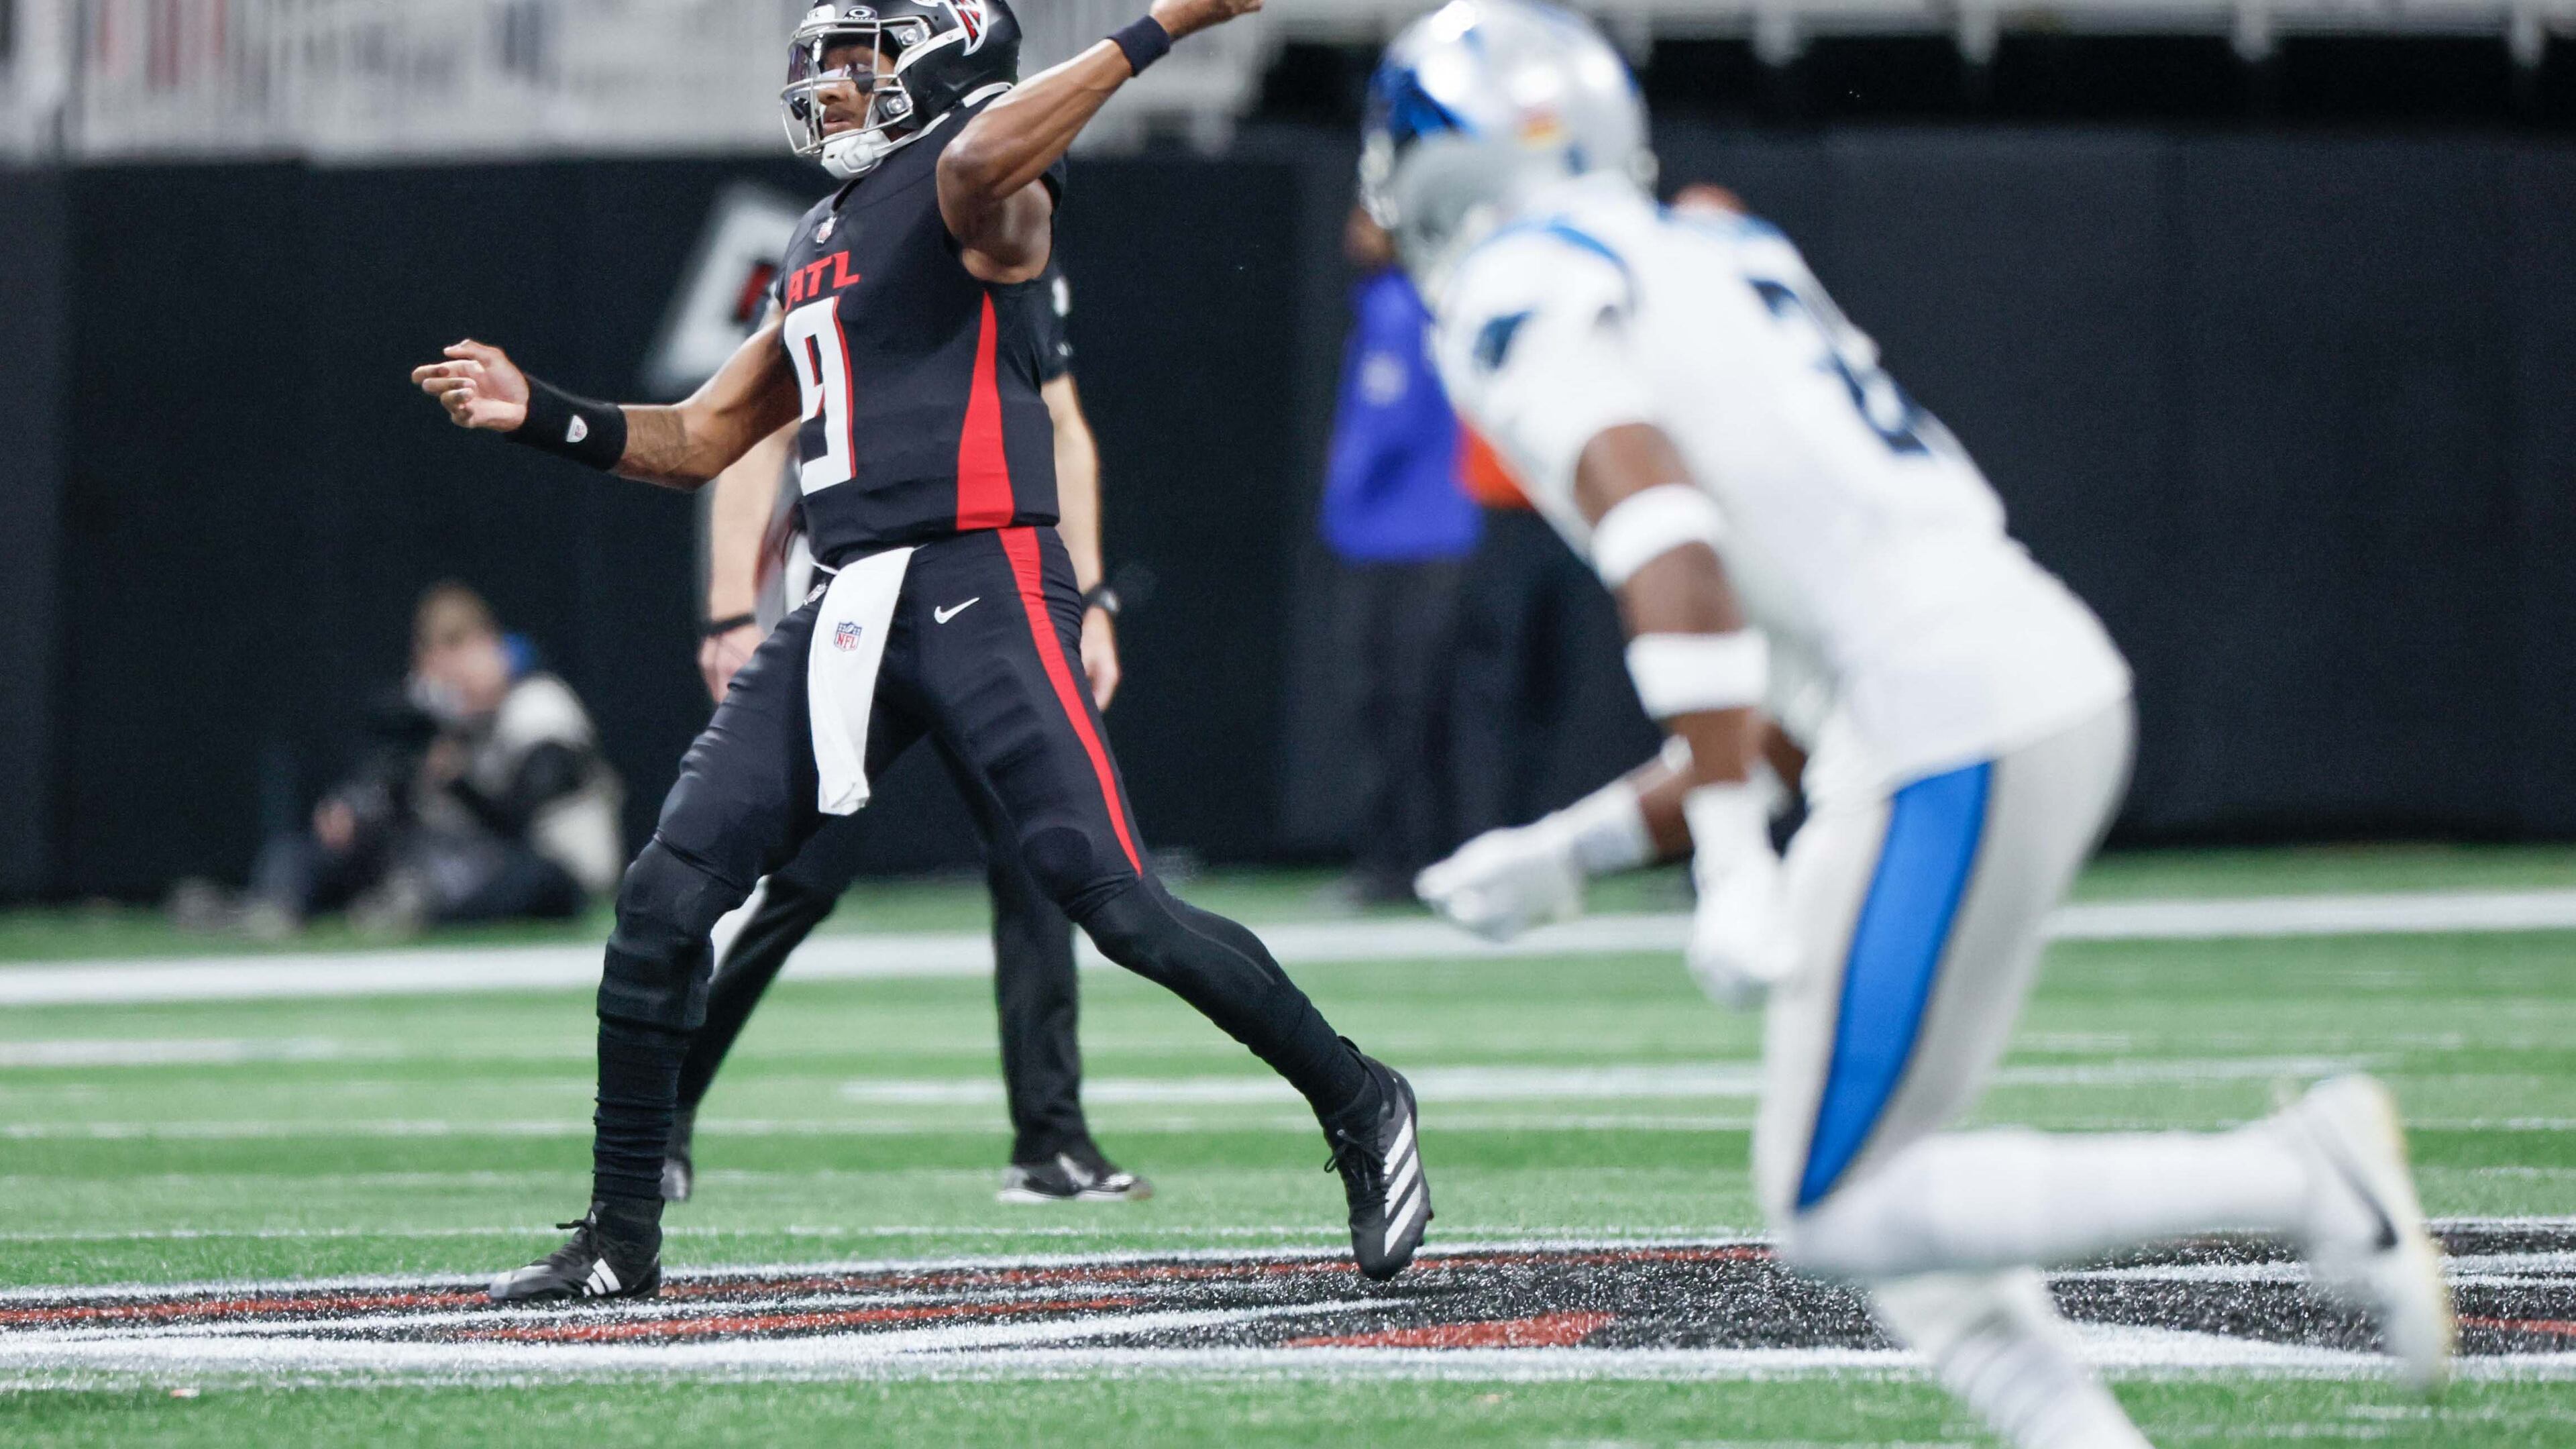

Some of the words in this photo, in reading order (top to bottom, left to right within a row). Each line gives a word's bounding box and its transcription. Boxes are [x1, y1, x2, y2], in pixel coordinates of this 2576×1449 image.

[786, 250, 861, 312] ATL
[784, 295, 857, 496] 9
[837, 633, 857, 649] NFL
